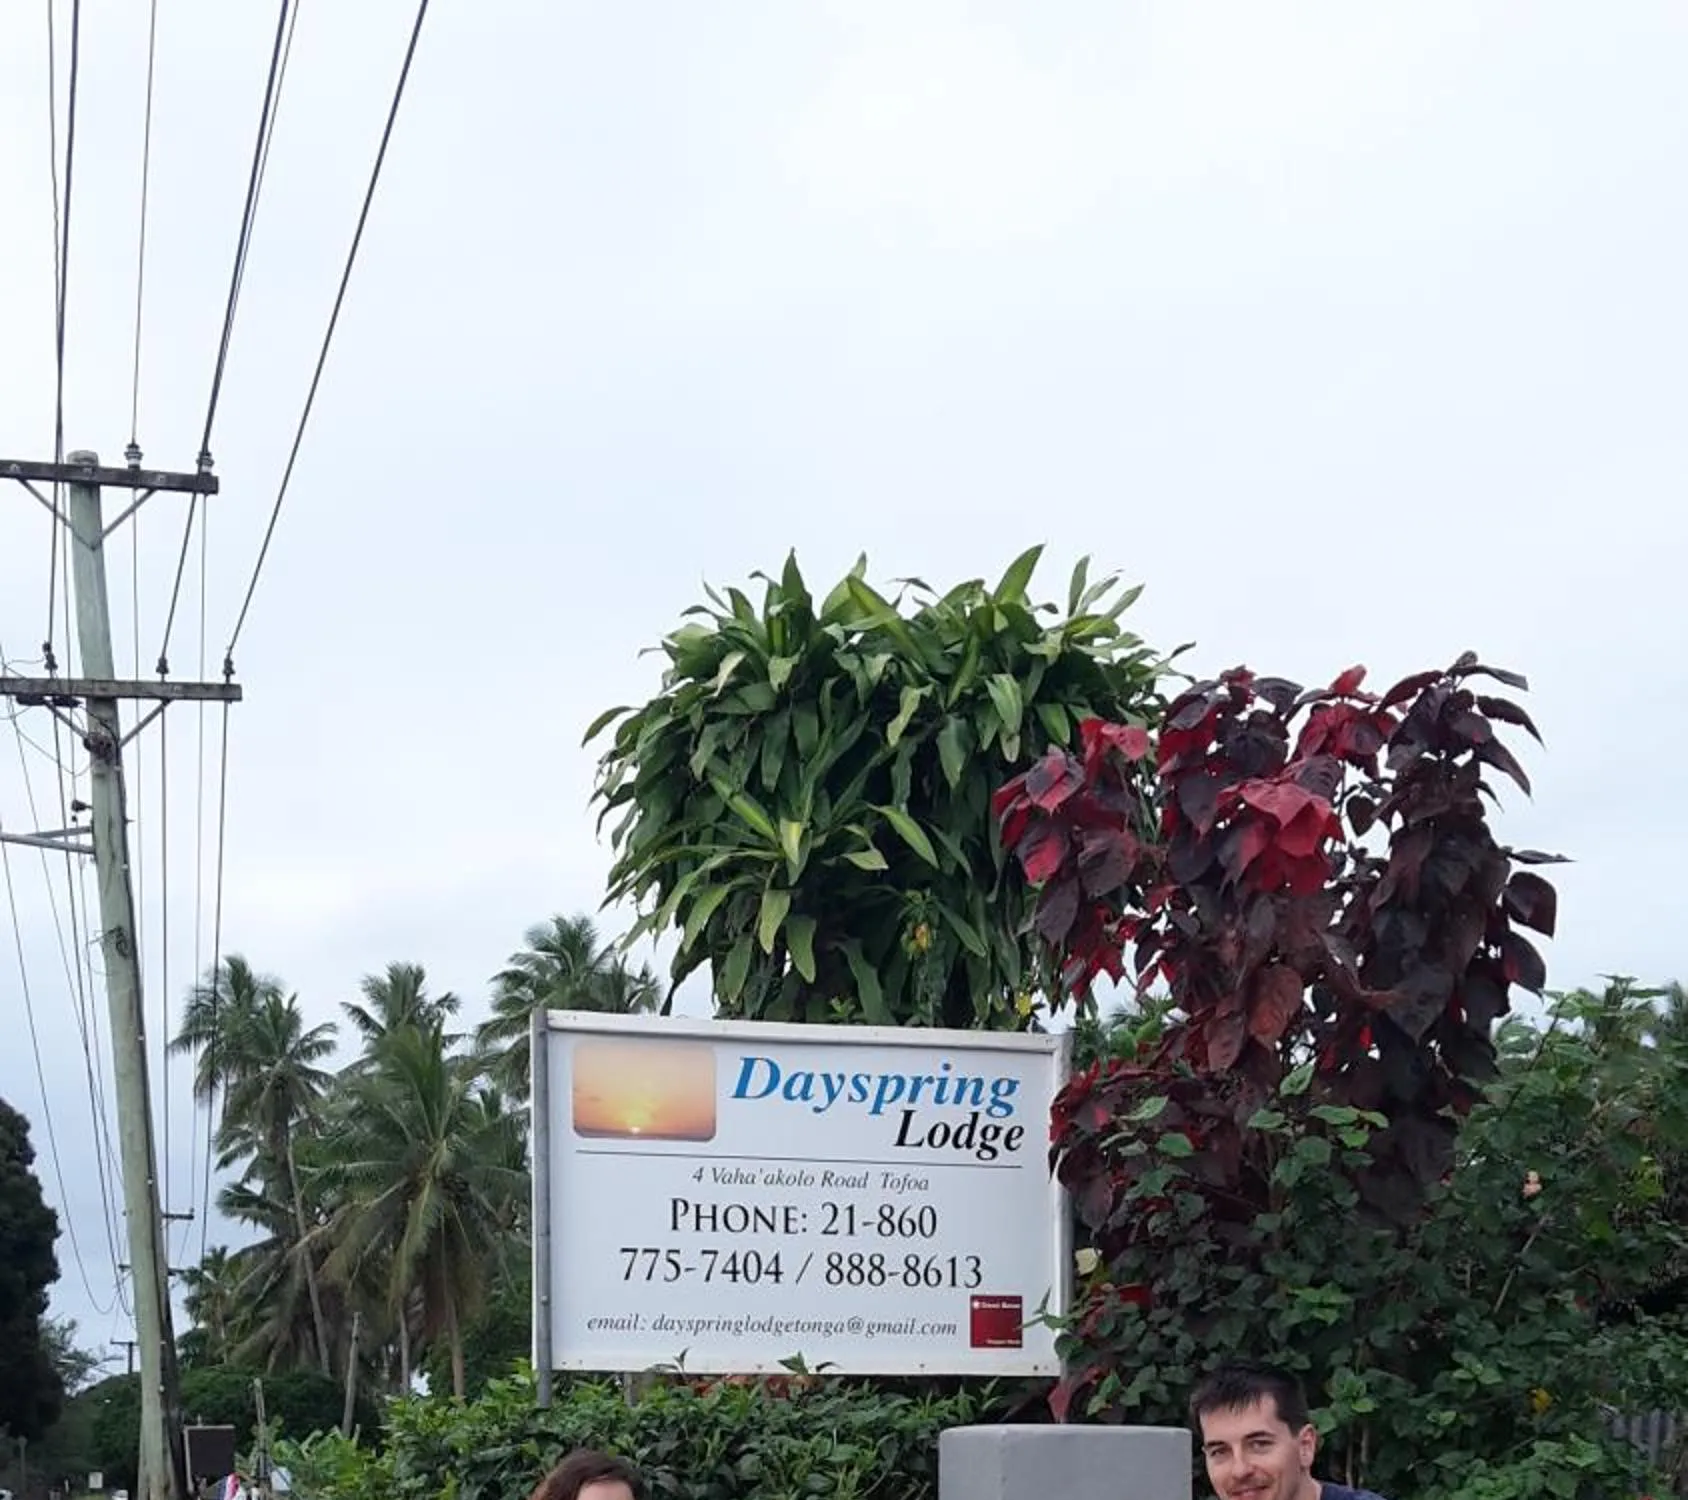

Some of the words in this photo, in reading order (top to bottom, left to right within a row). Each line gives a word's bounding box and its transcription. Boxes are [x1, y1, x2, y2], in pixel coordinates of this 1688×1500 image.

[731, 1056, 1021, 1118] Dayspring
[893, 1109, 1025, 1161] Lodge
[692, 1166, 703, 1183] 4
[712, 1167, 815, 1187] Vaha'akolo
[821, 1170, 869, 1189] Road
[881, 1172, 930, 1194] Tofoa
[821, 1201, 937, 1238] 21-860
[620, 1247, 784, 1284] 775-7404
[795, 1252, 813, 1285] /
[825, 1251, 983, 1289] 888-8613
[586, 1312, 646, 1332] email:
[652, 1313, 957, 1339] dayspringlodgetonga@gmail.com
